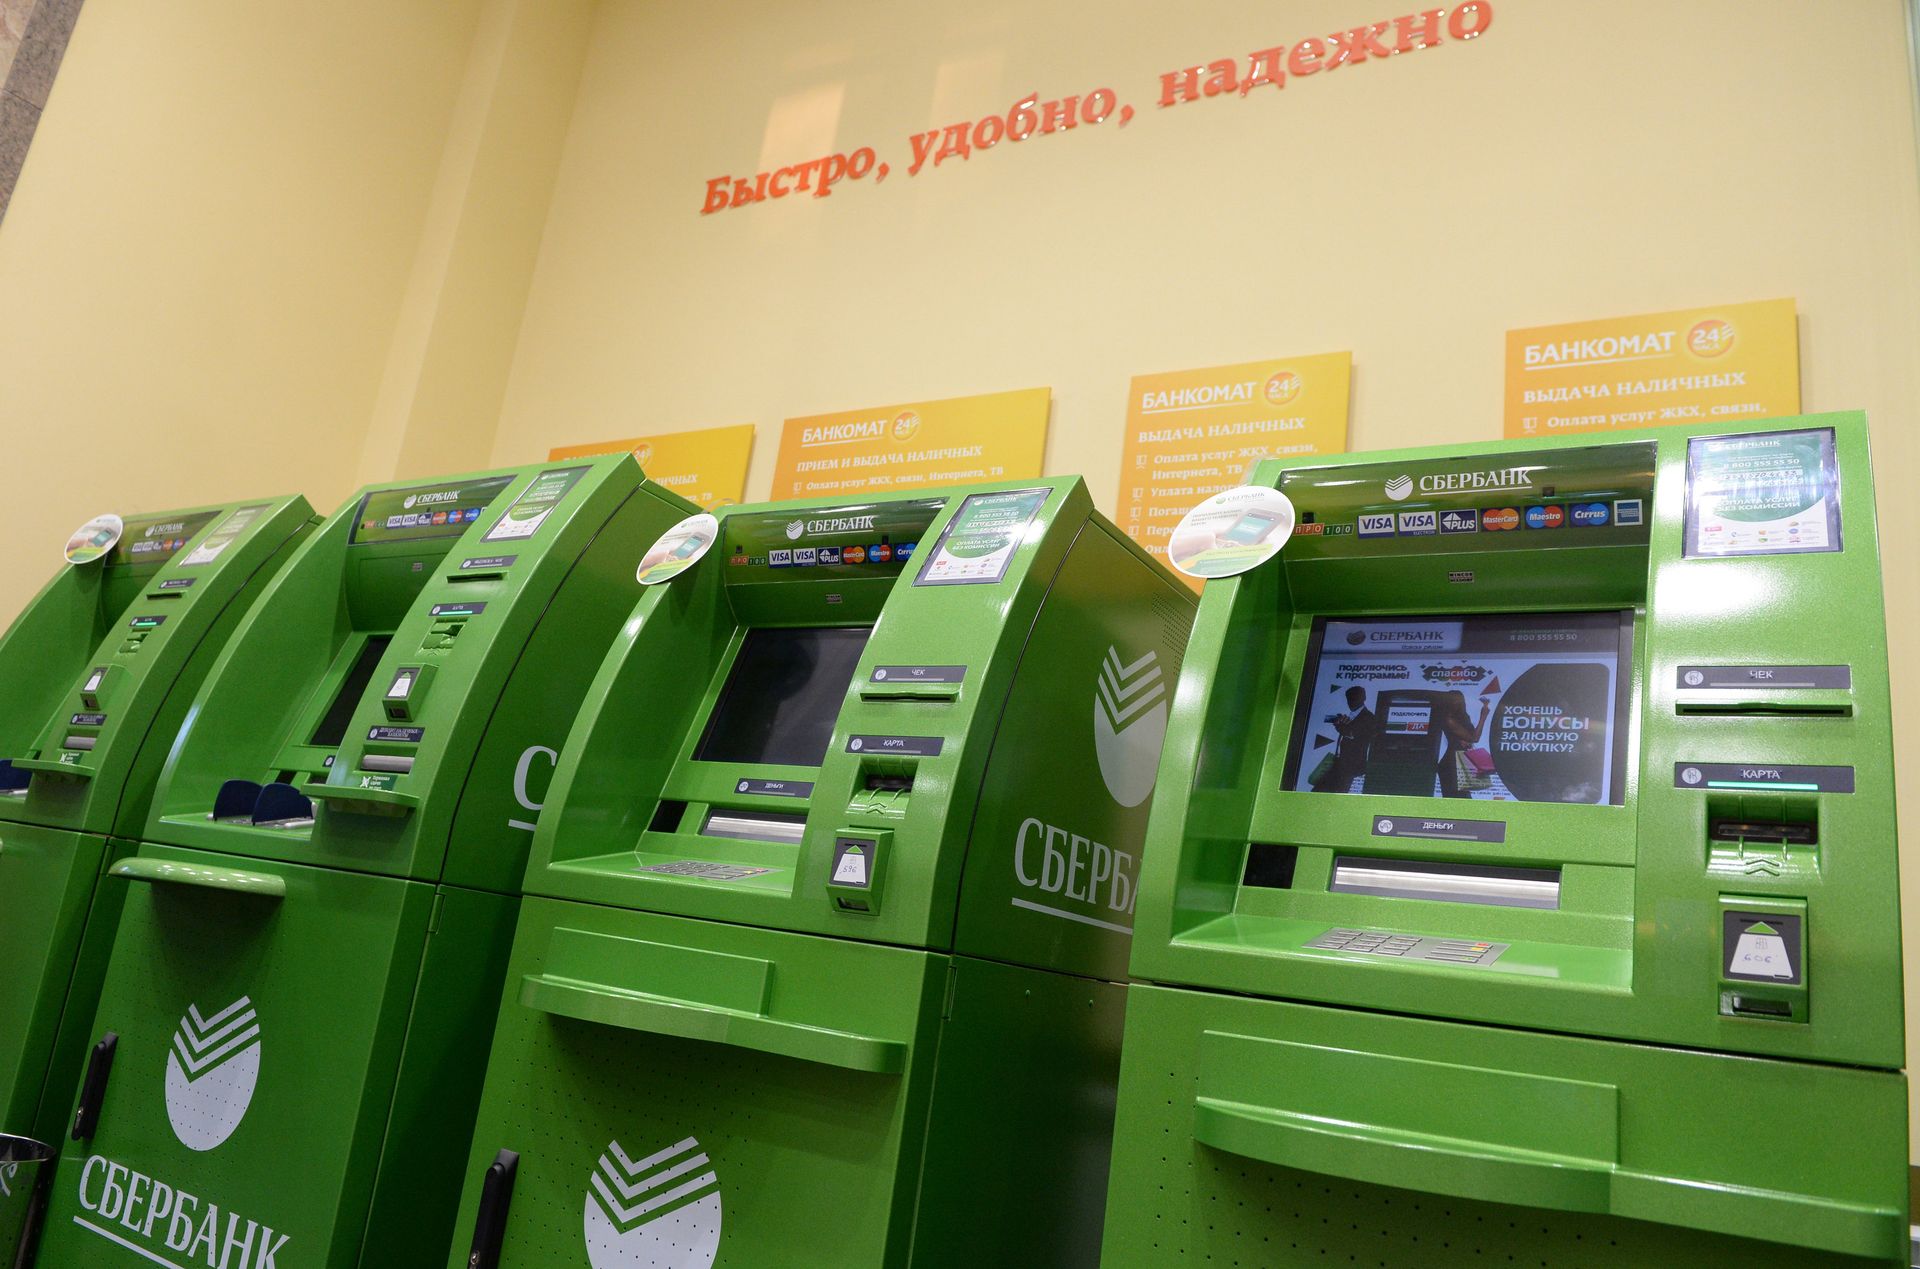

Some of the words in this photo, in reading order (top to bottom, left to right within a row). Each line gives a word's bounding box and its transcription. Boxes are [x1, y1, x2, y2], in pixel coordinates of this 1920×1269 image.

[699, 141, 890, 215] Быстро,
[907, 86, 1135, 176] удобно,
[1157, 0, 1494, 109] надежно
[1692, 328, 1718, 344] 24
[1524, 331, 1676, 365] БАНКОМАТ
[1269, 379, 1289, 393] 24
[1523, 383, 1611, 404] ВЫДАЧА
[1616, 371, 1746, 396] НАЛИЧНЫХ
[1142, 381, 1257, 409] БАНКОМАТ
[895, 418, 910, 430] 24
[1546, 414, 1606, 428] Оплата
[1610, 409, 1655, 426] услуг
[802, 420, 888, 443] БАНКОМАТ
[1138, 423, 1204, 443] ВЫДАЧА
[1208, 417, 1305, 437] НАЛИЧНЫХ
[796, 455, 838, 473] ПРИЕМ
[841, 456, 851, 469] И
[853, 450, 905, 468] ВЫДАЧА
[907, 445, 983, 463] НАЛИЧНЫХ
[1153, 453, 1198, 464] Оплата
[1201, 451, 1235, 463] услуг
[806, 479, 839, 491] Оплата
[841, 478, 865, 489] услуг
[989, 465, 1004, 476] ТВ
[1152, 468, 1222, 481] Интернета,
[1226, 465, 1243, 475] ТВ
[1419, 467, 1533, 491] СБЕРБАНК
[417, 490, 460, 501] СБЕРБАНК
[1151, 487, 1193, 498] Уплата
[1482, 515, 1519, 524] MasterCard
[1529, 512, 1560, 521] Maestro
[1574, 510, 1606, 519] Cirrus
[807, 515, 875, 533] СБЕРБАНК
[1362, 517, 1392, 530] VISA
[1401, 515, 1434, 527] VISA
[1450, 519, 1476, 530] PLUS
[771, 552, 790, 561] VISA
[795, 550, 814, 560] VISA
[824, 554, 839, 563] PLUS
[1370, 630, 1444, 641] СБЕРБАНК
[1431, 665, 1478, 678] спасибо
[1750, 670, 1773, 680] ЧЕК
[1504, 705, 1563, 715] ХОЧЕШЬ
[1502, 716, 1590, 730] БОНУСЫ
[1501, 731, 1518, 740] ЗА
[1520, 731, 1579, 742] ЛЮБУЮ
[882, 739, 904, 747] КАРТА
[1500, 742, 1574, 753] ПОКУПКУ?
[1742, 769, 1780, 780] КАРТА
[1422, 821, 1454, 830] ДЕНЬГИ
[78, 1154, 291, 1269] СБЕРБАНК
